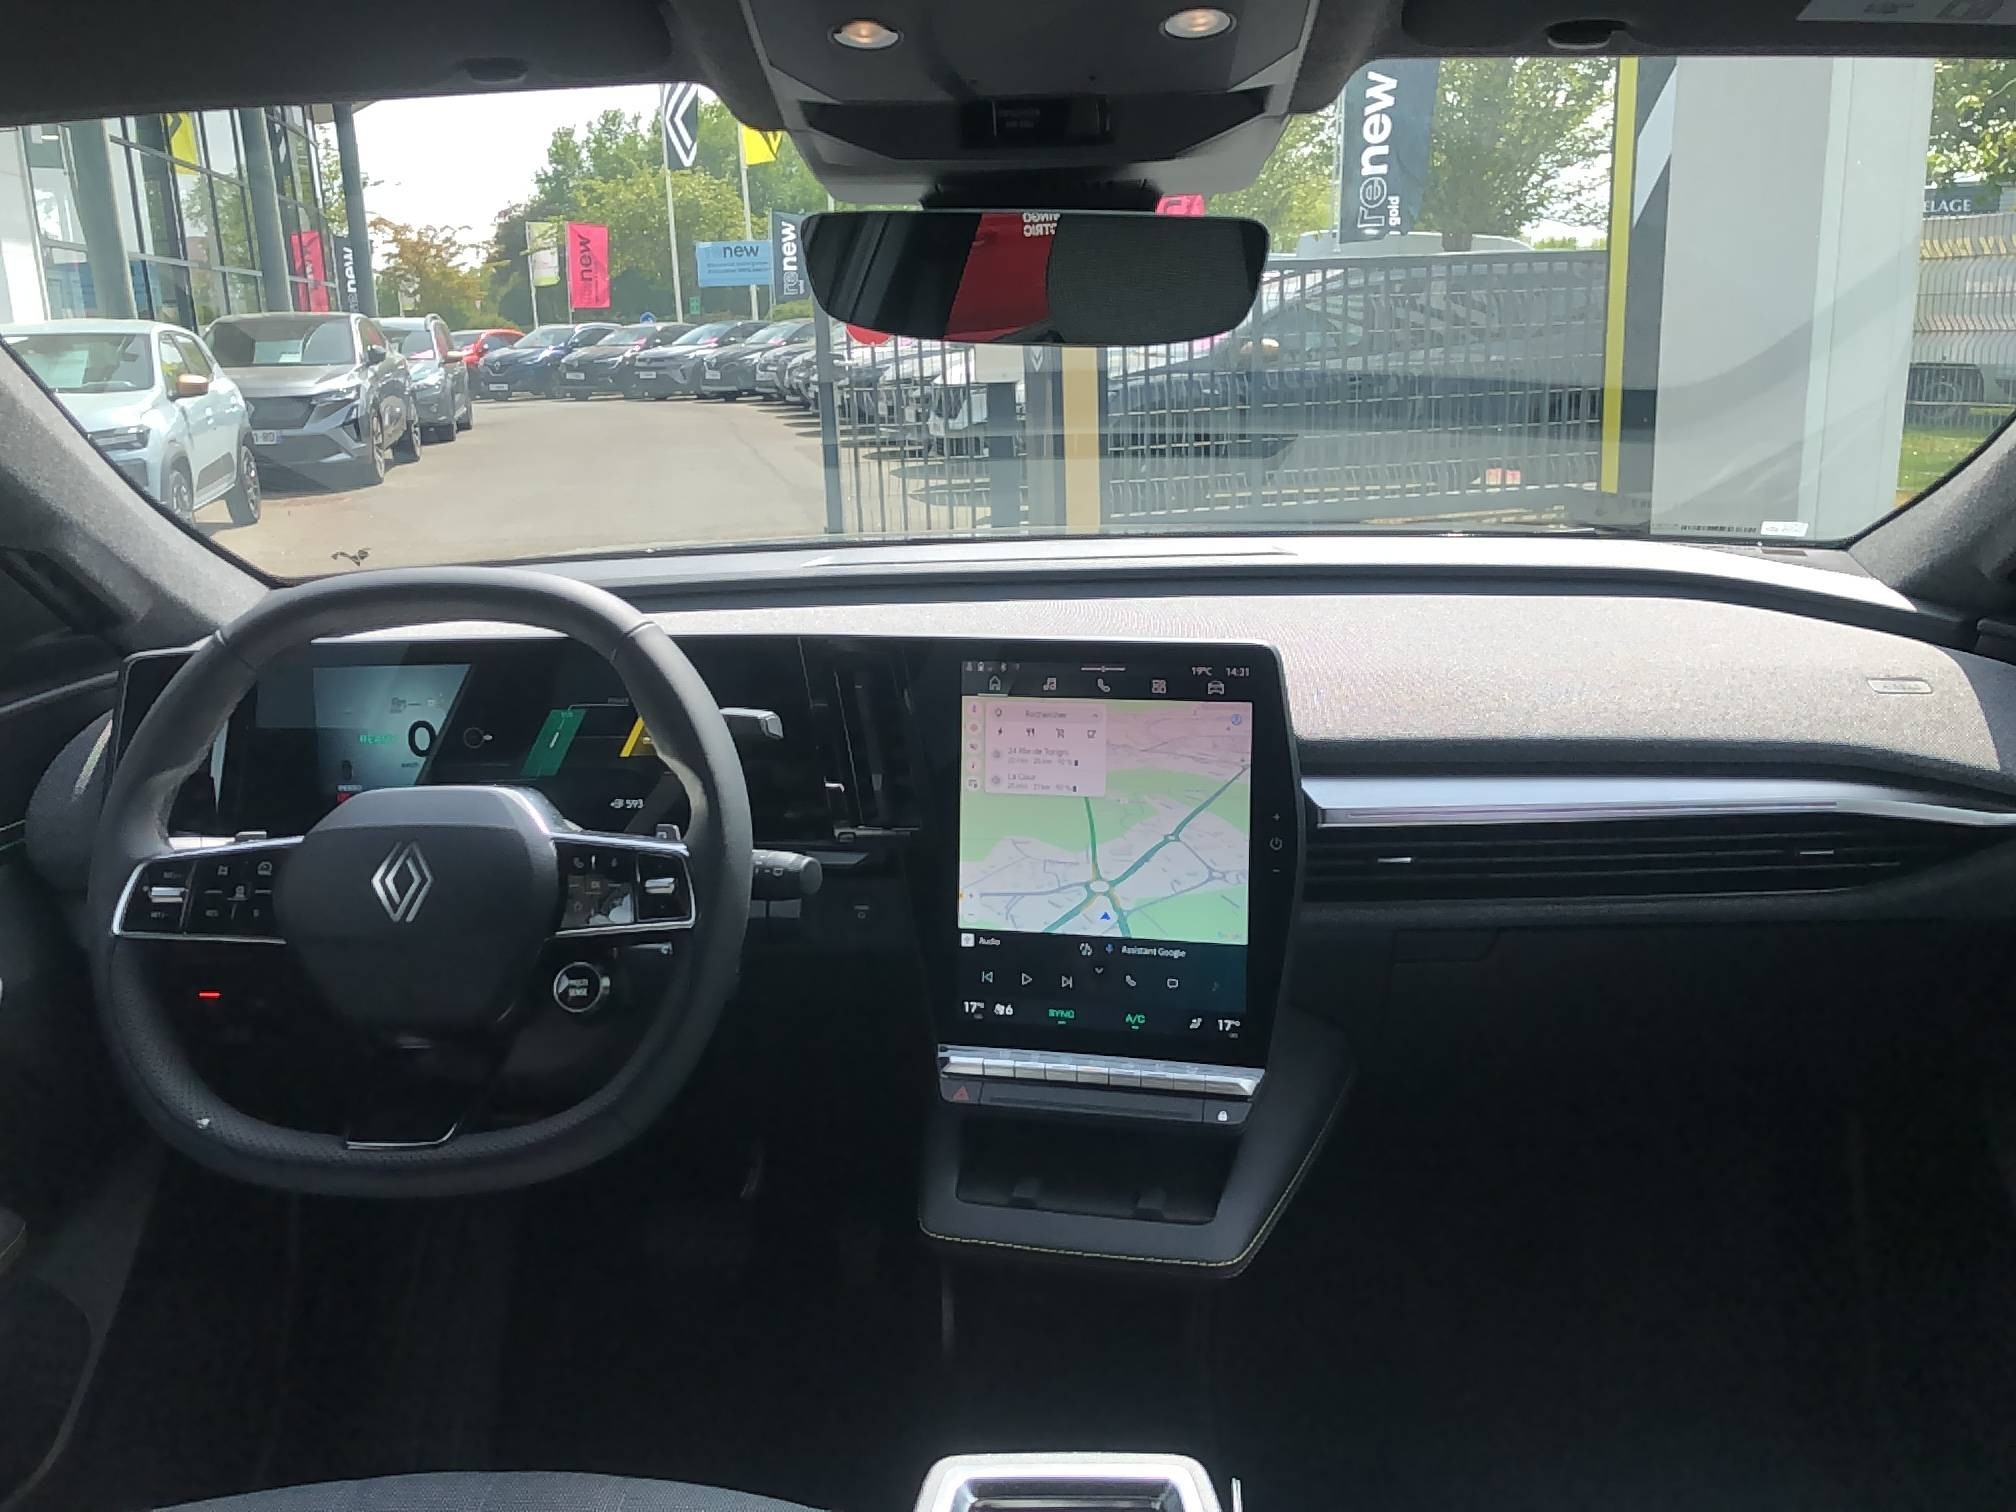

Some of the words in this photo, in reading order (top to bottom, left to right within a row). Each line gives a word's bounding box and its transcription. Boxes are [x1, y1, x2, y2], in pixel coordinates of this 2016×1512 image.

[1357, 71, 1398, 229] renew
[1388, 195, 1402, 227] gold
[781, 220, 799, 296] renew
[408, 720, 437, 758] 0
[625, 799, 644, 809] 593
[978, 937, 1001, 946] Audio
[1121, 945, 1157, 957] Assistant
[1158, 947, 1187, 959] Google
[1125, 1013, 1146, 1025] A/C
